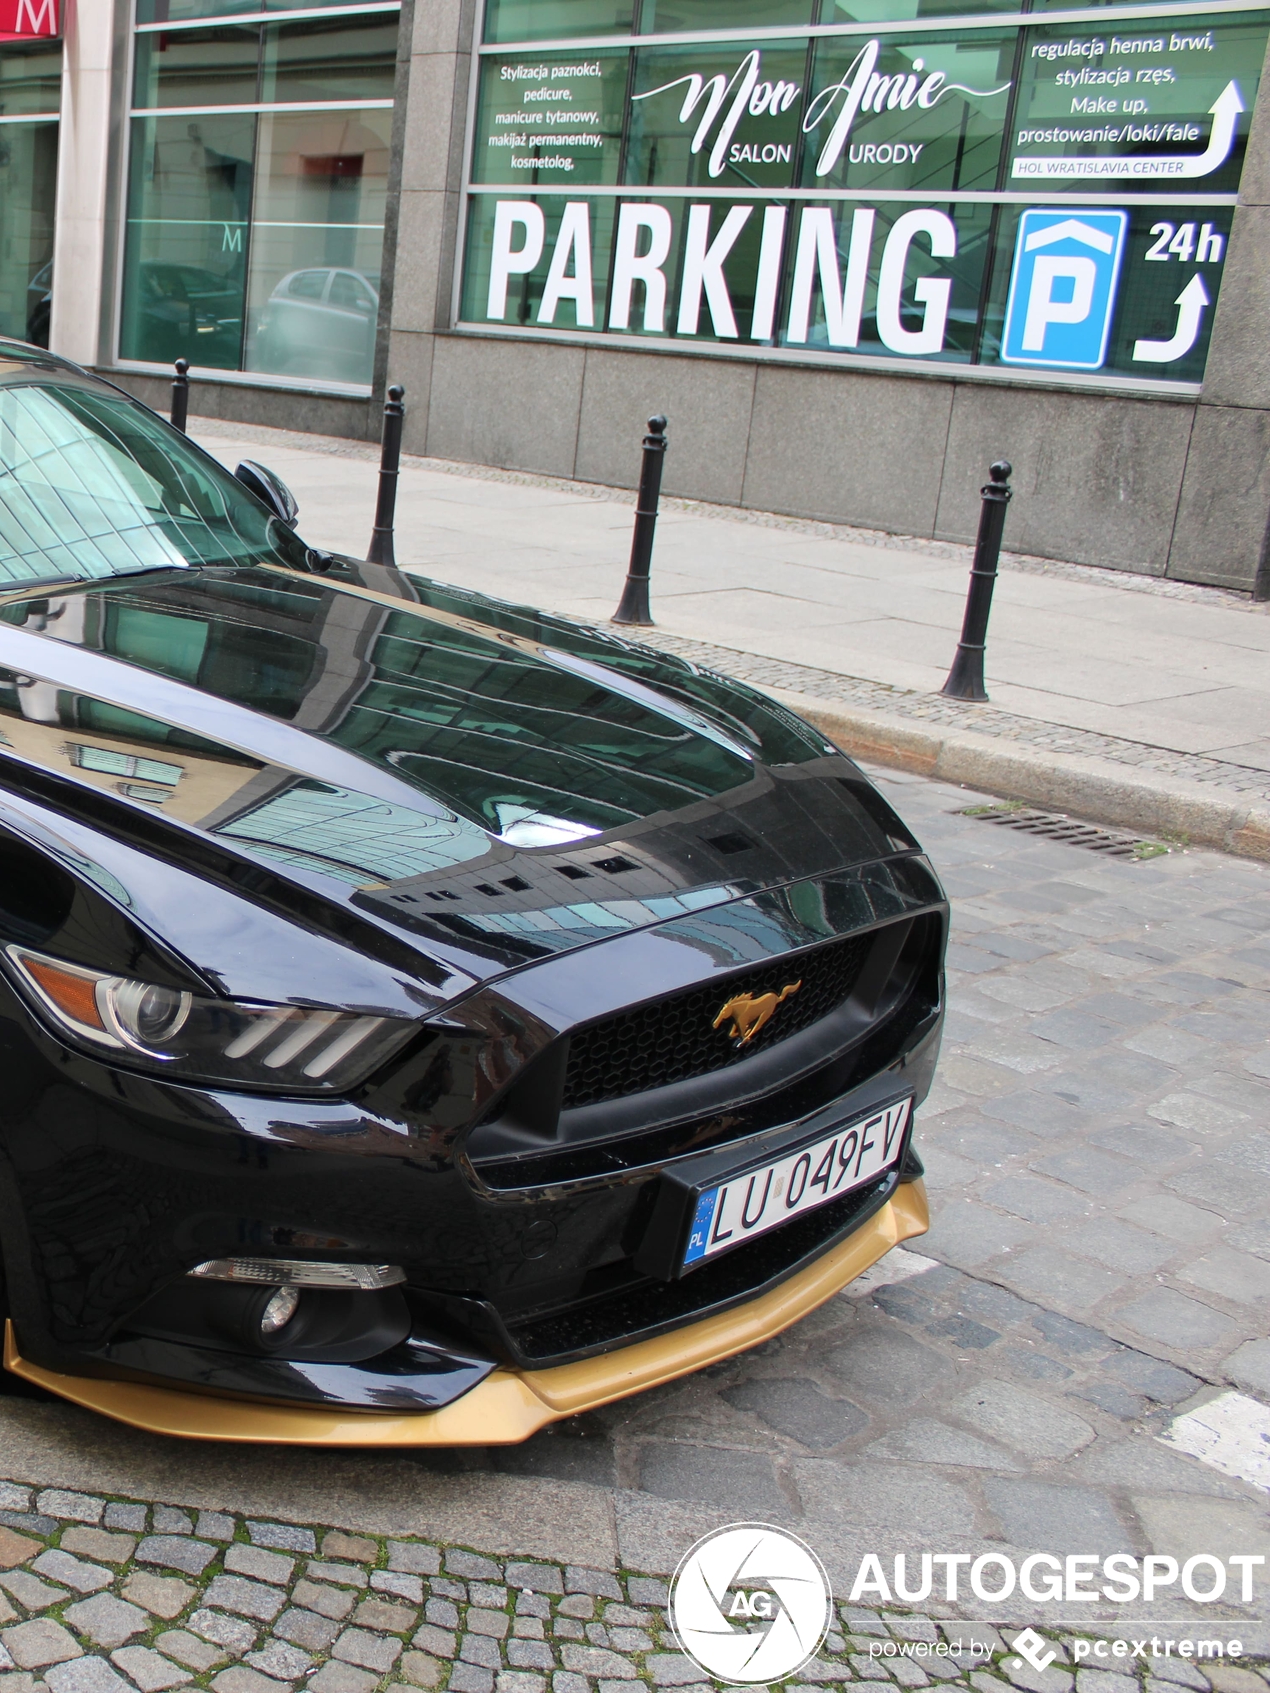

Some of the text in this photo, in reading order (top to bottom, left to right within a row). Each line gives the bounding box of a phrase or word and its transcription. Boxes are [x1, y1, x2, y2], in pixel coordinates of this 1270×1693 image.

[15, 0, 58, 36] M
[1031, 32, 1215, 60] regulacja henna brwi,
[500, 61, 602, 82] Stylizacja paznokci,
[1055, 67, 1176, 88] stylizacja rzęs,
[523, 87, 573, 103] pedicure,
[631, 39, 1012, 179] Mon Amie
[1070, 96, 1149, 116] Make up,
[495, 110, 599, 125] manicure tytanowy,
[488, 132, 603, 149] makijaż permanentny,
[1017, 123, 1200, 146] prostowanie/loki/fale
[511, 154, 575, 171] kosmetolog,
[729, 144, 792, 163] SALON
[849, 144, 924, 164] URODY
[1018, 162, 1185, 174] HOL WRATISLAVIA CENTER
[221, 224, 242, 252] M
[1145, 222, 1223, 263] 24h
[485, 200, 958, 355] PARKING
[1021, 256, 1097, 351] P
[711, 1103, 905, 1246] LU 049FV
[689, 1232, 704, 1250] PL
